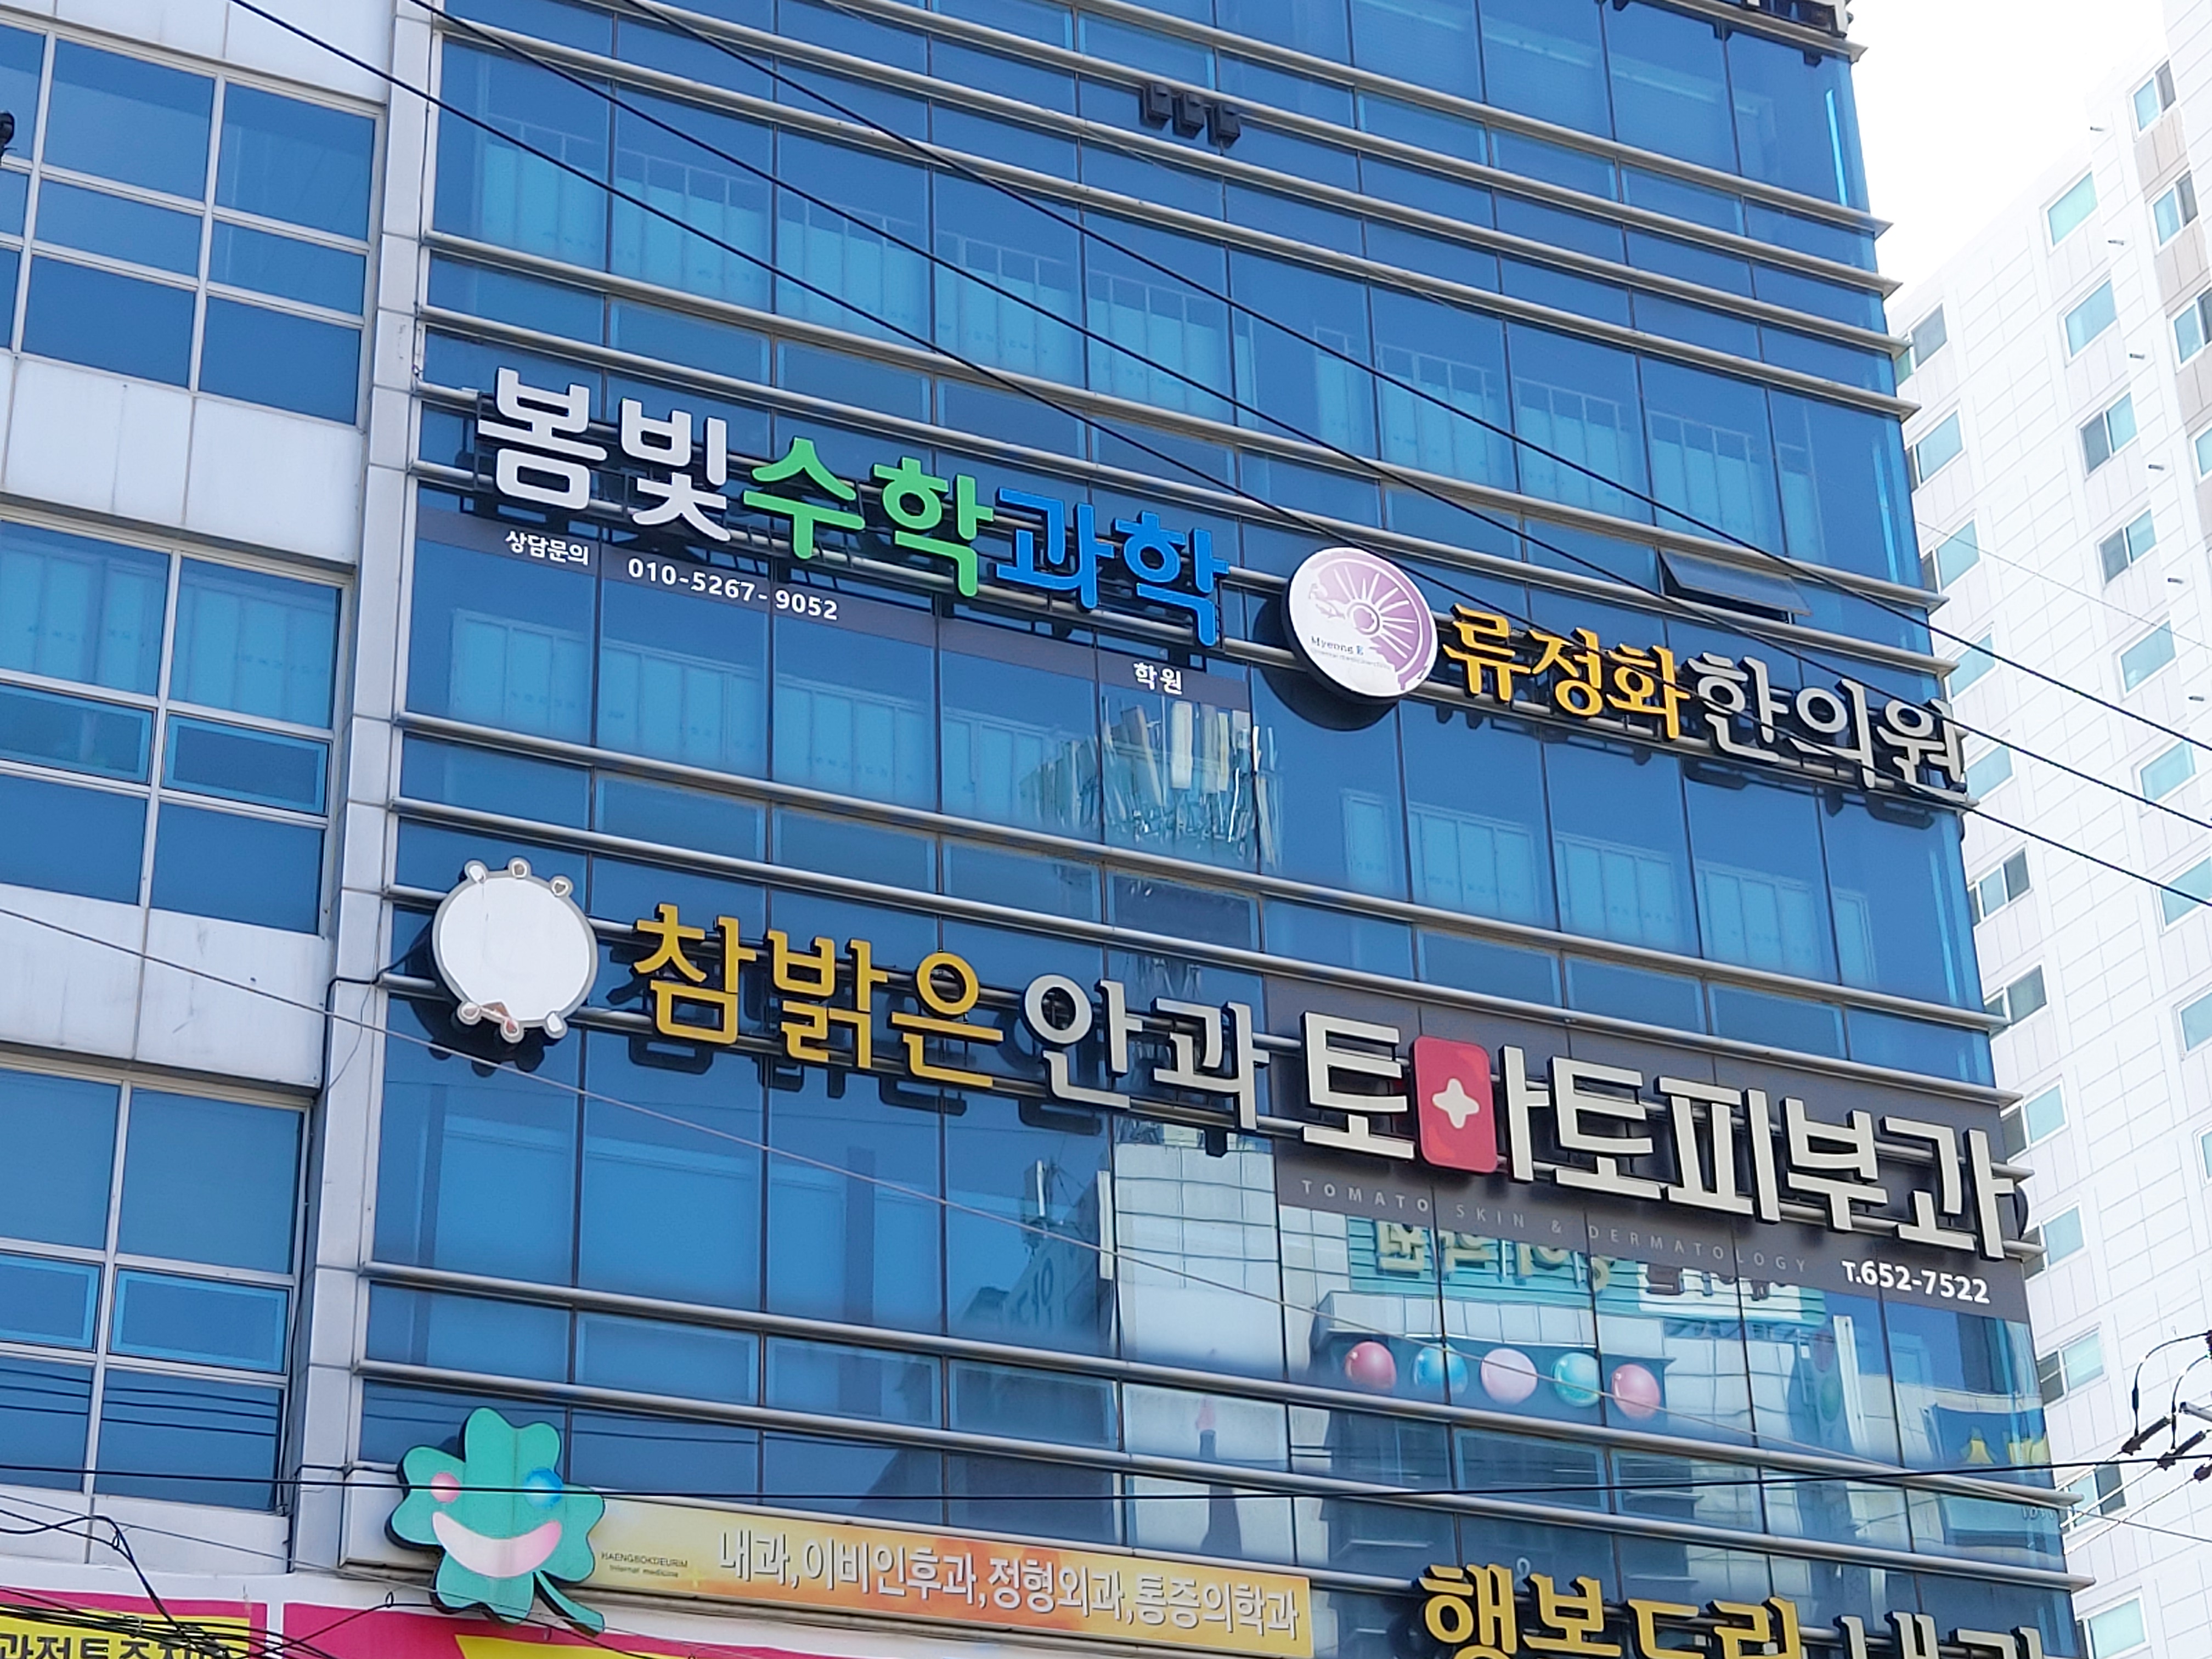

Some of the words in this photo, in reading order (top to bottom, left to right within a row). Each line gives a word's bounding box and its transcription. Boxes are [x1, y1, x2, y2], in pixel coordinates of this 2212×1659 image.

[505, 529, 589, 566] 상담문의
[1133, 662, 1183, 695] 학원
[1301, 1180, 1429, 1213] TOMATO
[1456, 1207, 1525, 1229] SKIN
[1551, 1219, 1563, 1234] &
[1589, 1224, 1807, 1273] DERMATOLOGY
[1841, 1260, 1990, 1304] T.652-7522
